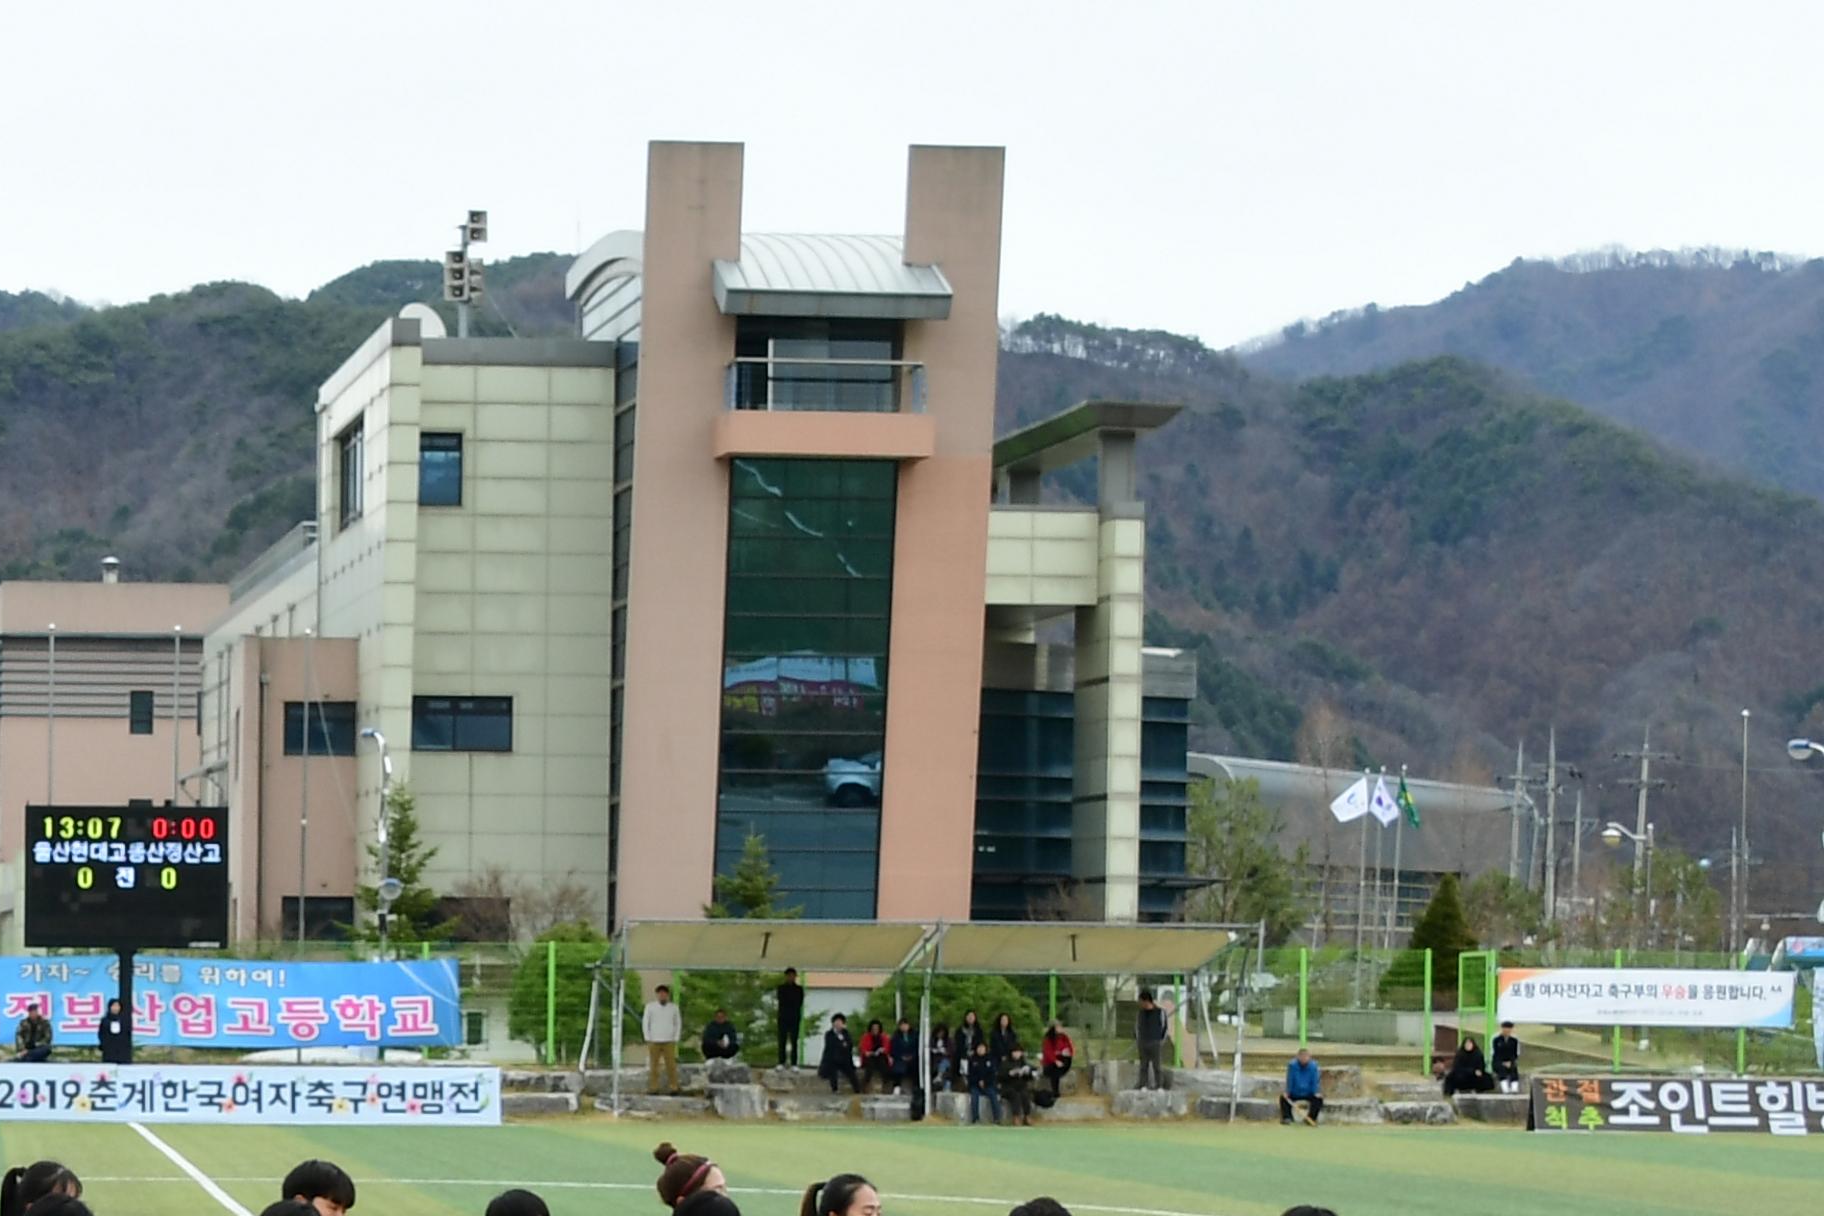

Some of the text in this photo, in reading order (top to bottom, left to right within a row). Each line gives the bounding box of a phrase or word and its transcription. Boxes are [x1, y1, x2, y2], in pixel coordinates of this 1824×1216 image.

[44, 816, 214, 839] 13:07 0:00
[77, 866, 94, 889] 0
[160, 866, 177, 890] 0
